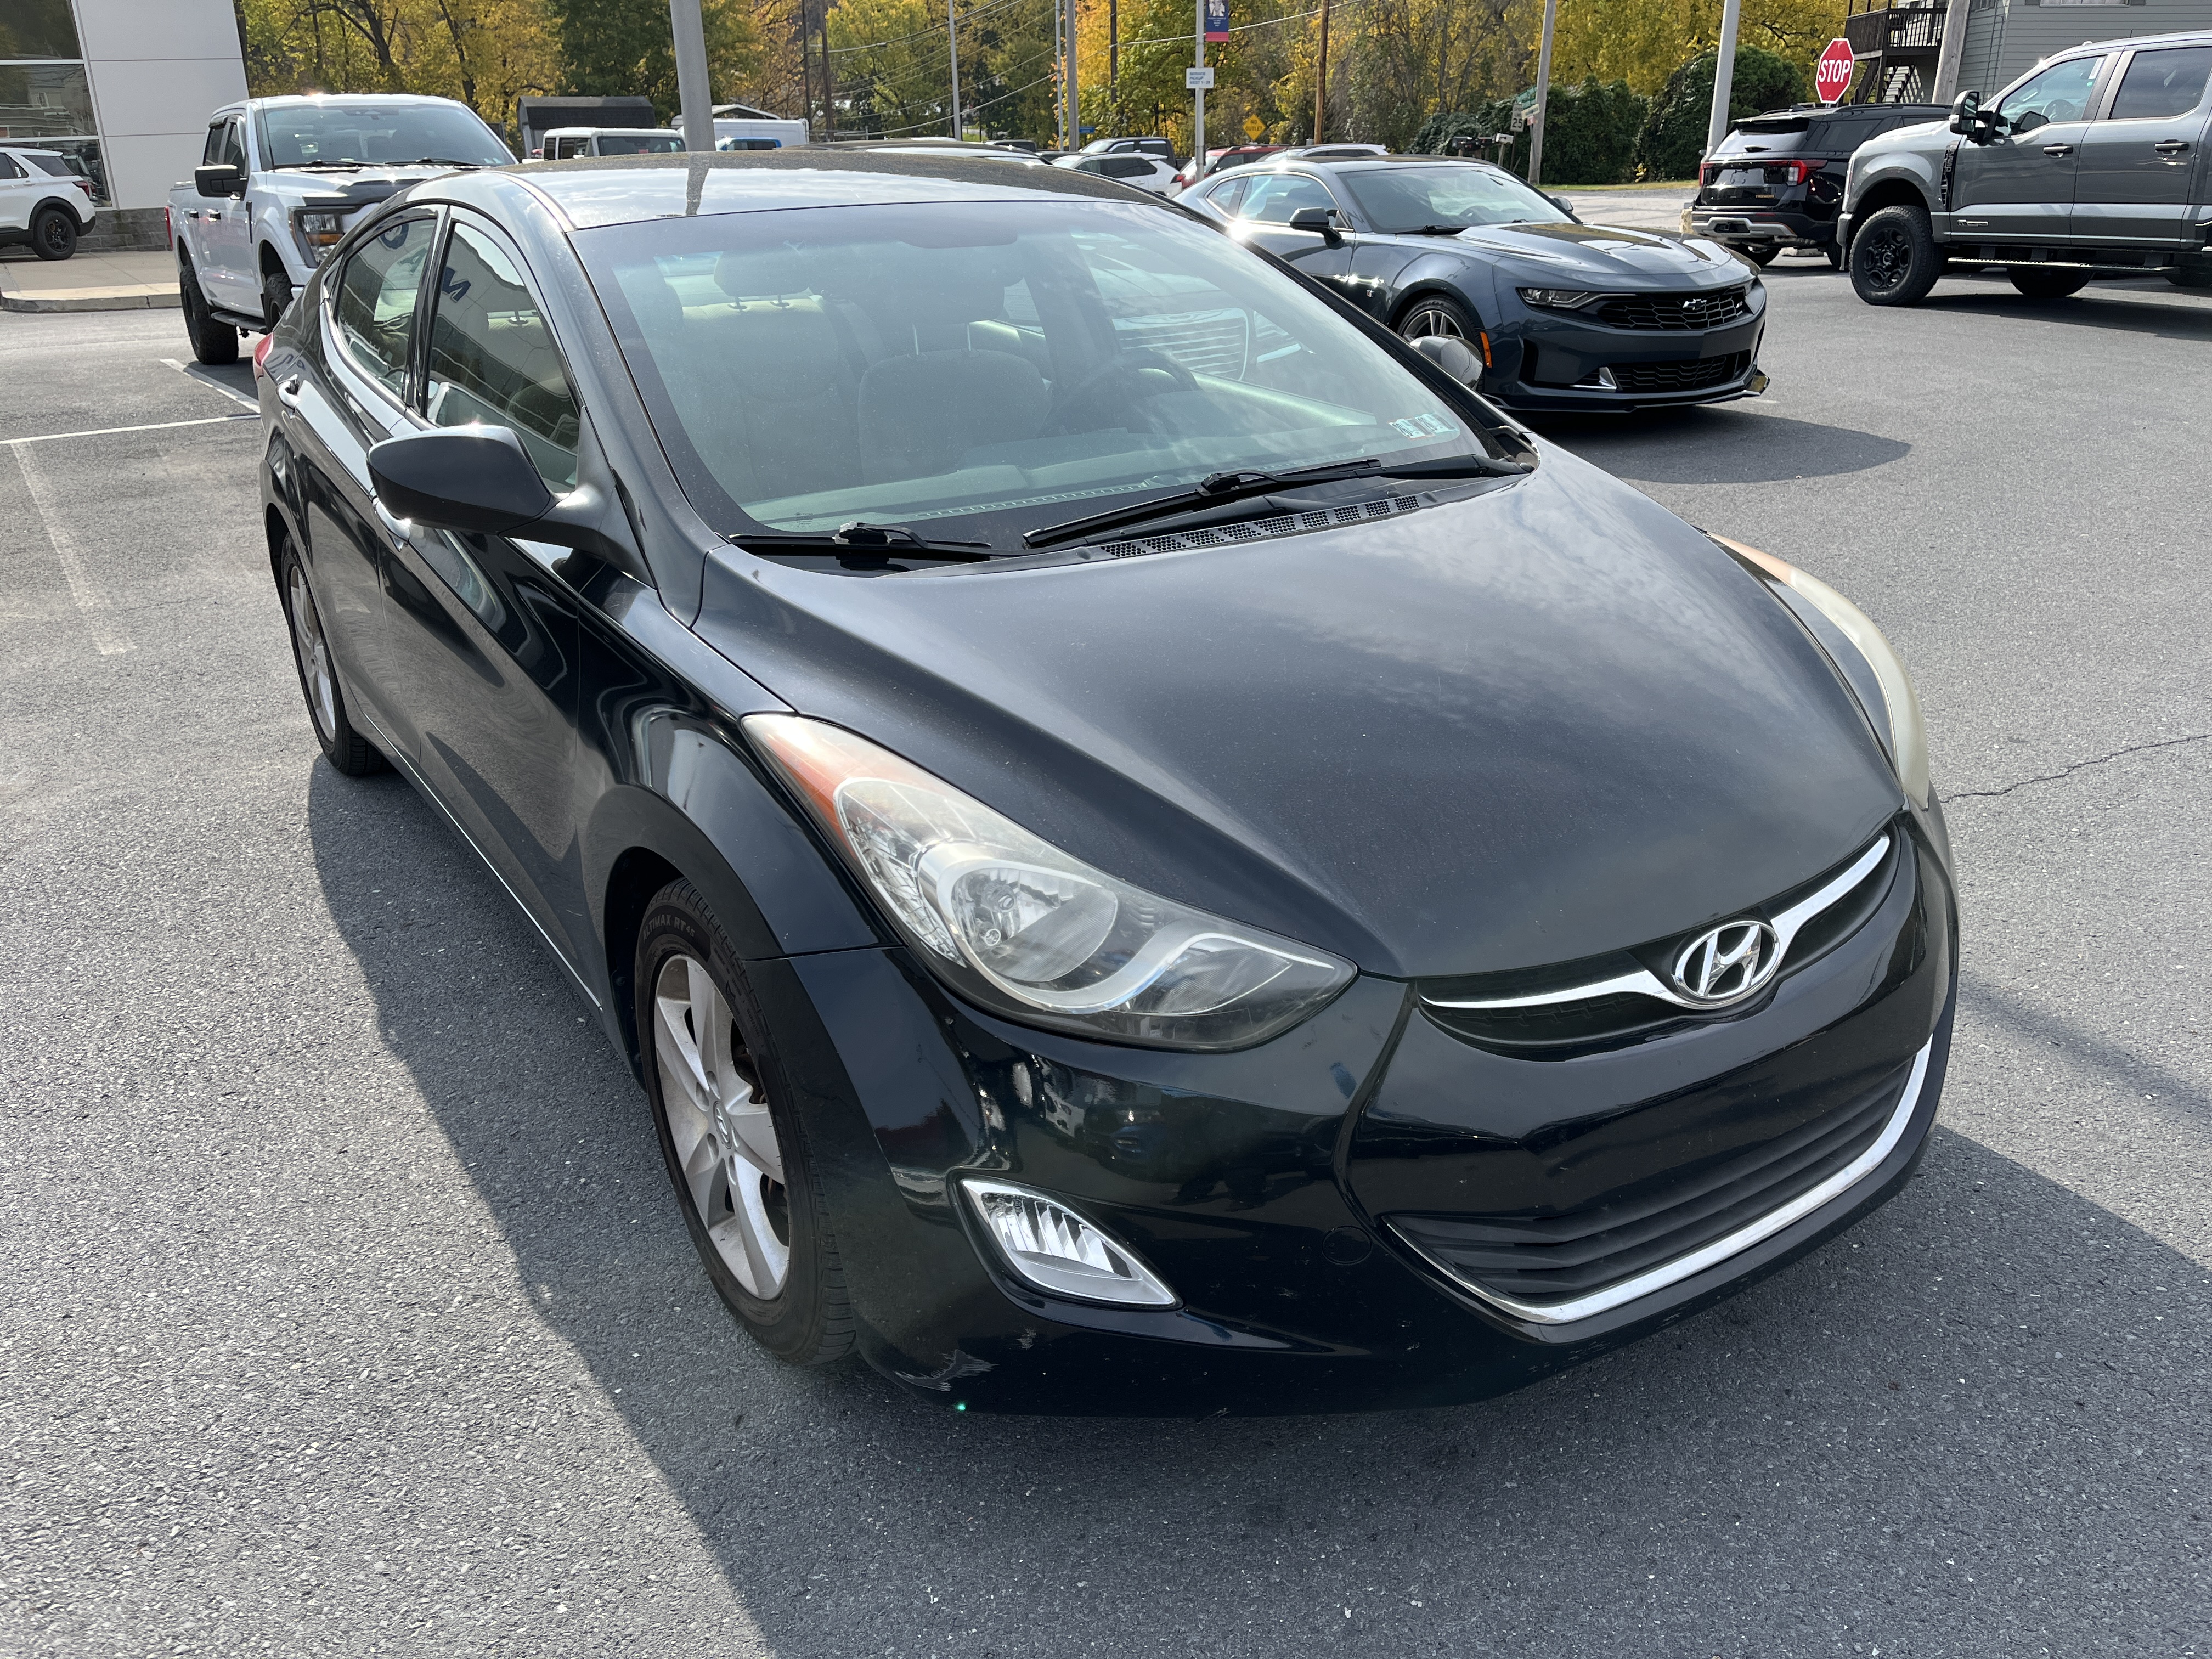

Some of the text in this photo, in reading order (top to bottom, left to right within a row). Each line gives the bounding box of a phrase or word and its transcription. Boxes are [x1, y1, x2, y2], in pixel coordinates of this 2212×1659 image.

[1819, 59, 1851, 83] STOP
[1512, 118, 1523, 128] 25
[643, 914, 672, 940] ALTIMAX
